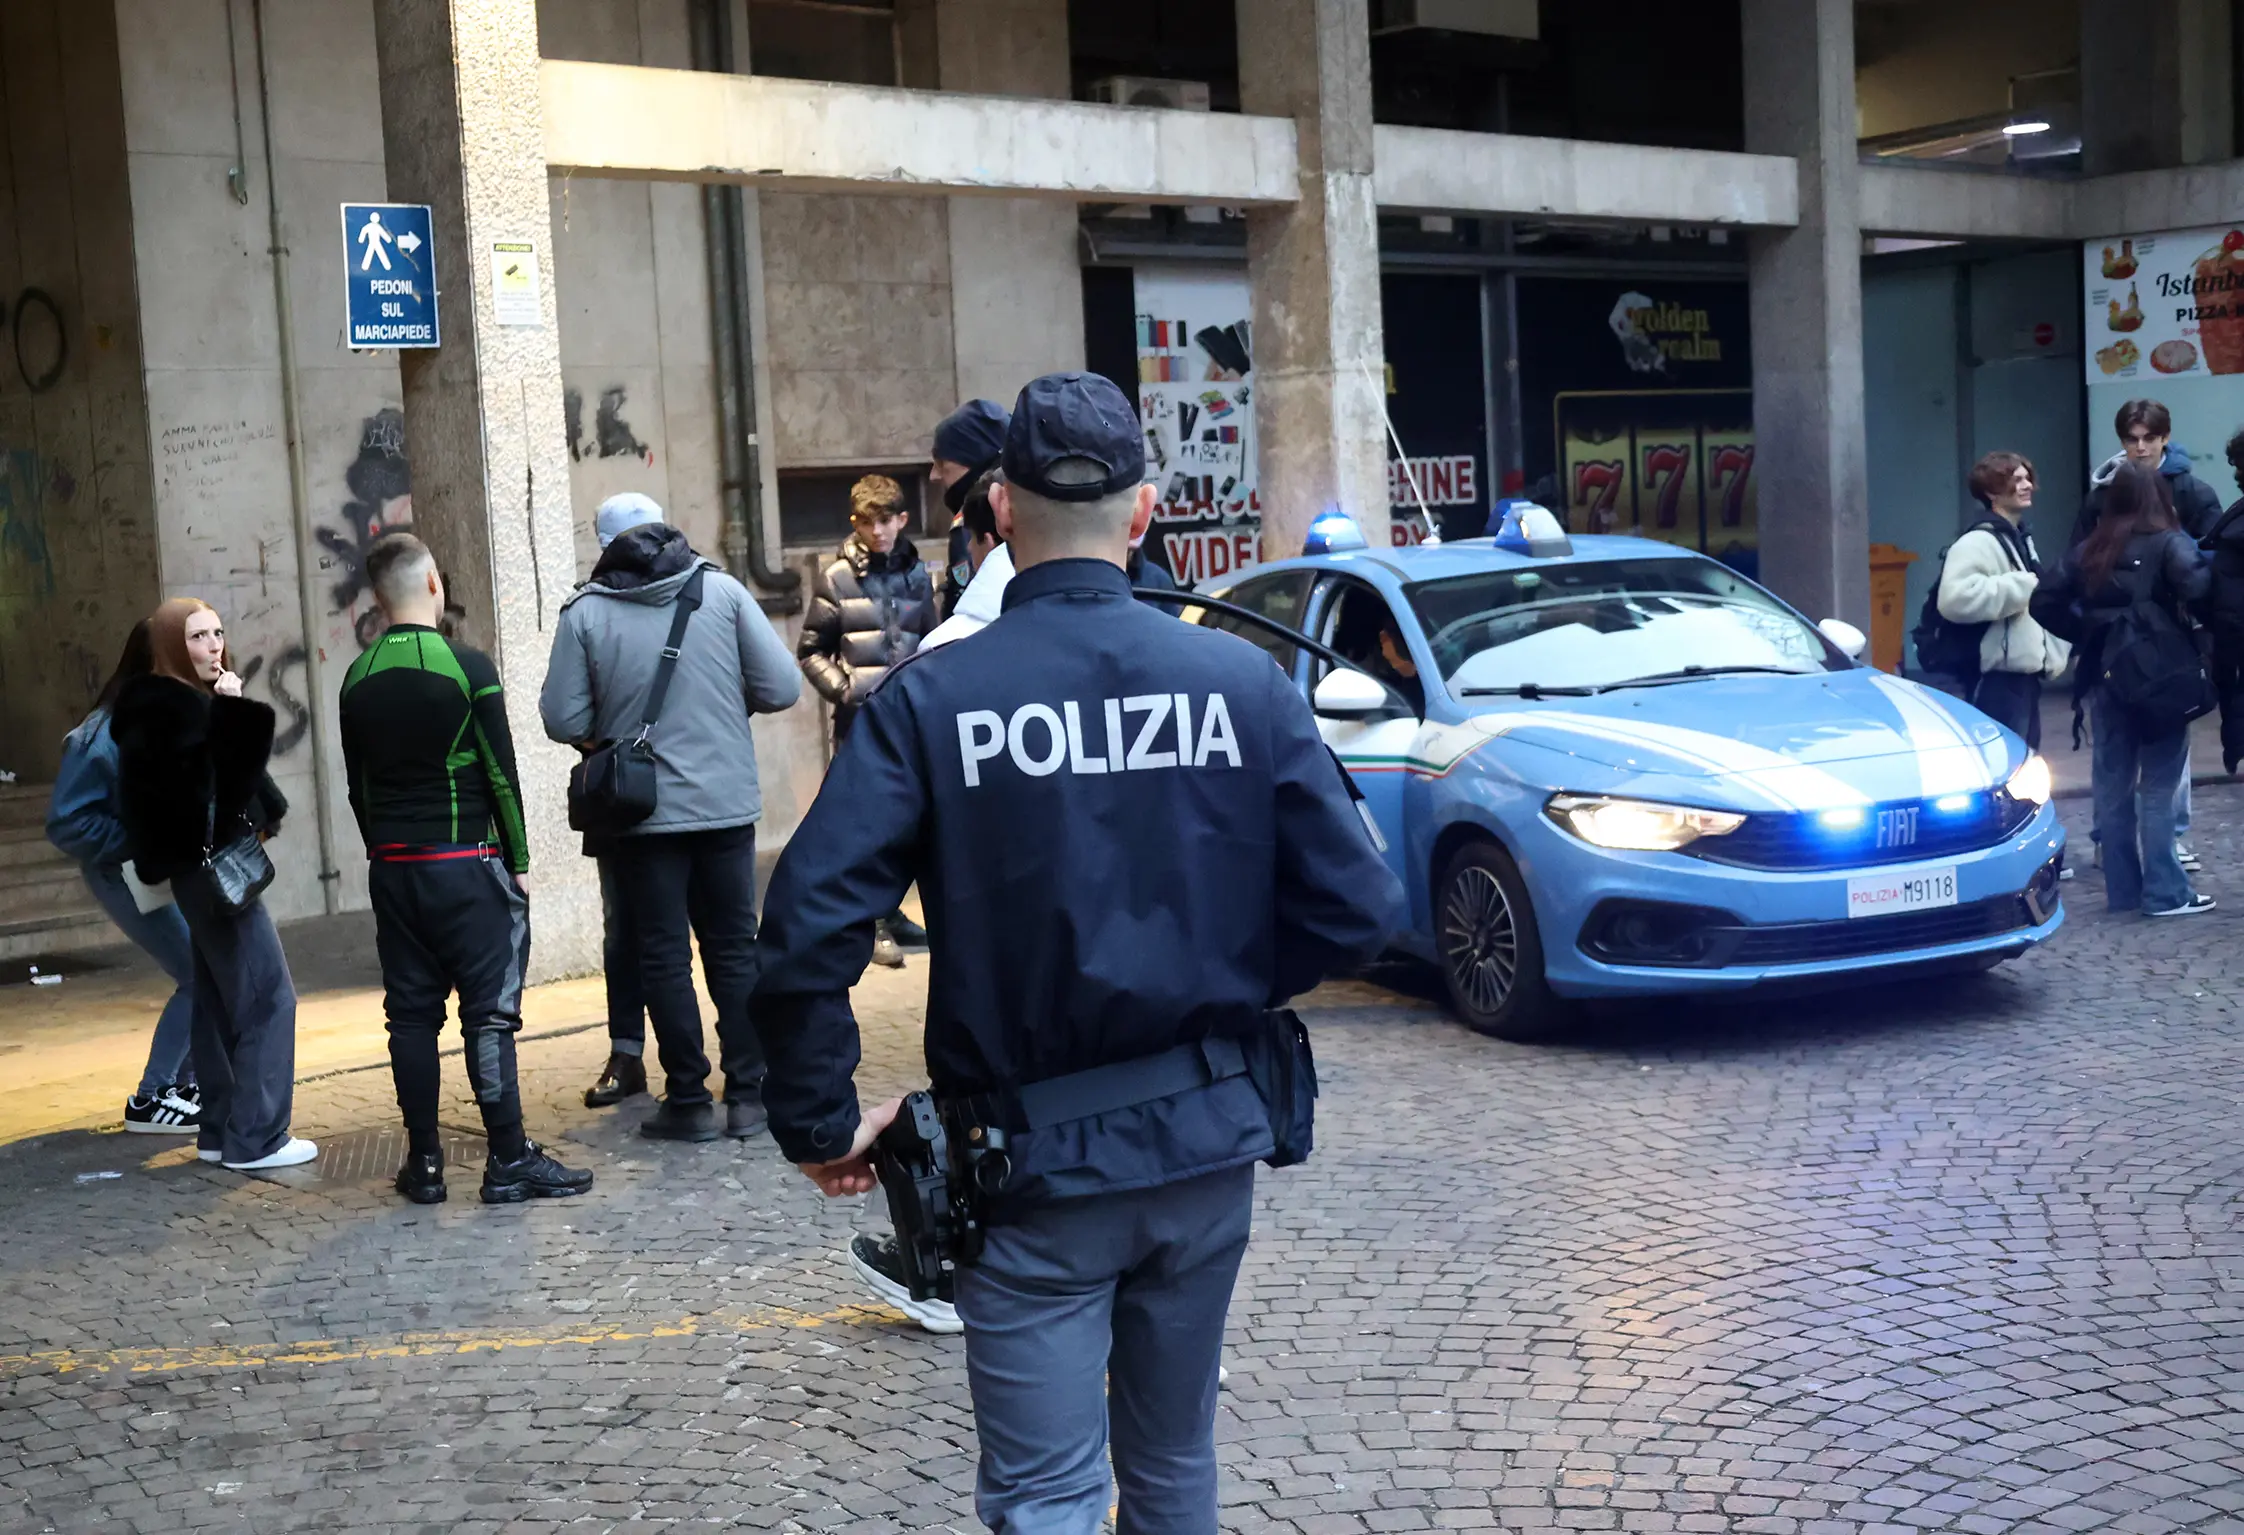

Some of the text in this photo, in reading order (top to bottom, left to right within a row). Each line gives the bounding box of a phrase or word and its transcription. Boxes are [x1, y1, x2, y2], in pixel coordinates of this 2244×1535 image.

[370, 280, 412, 295] PEDONI
[381, 302, 404, 317] SUL
[355, 324, 431, 340] MARCIAPIEDE
[957, 693, 1242, 788] POLIZIA
[1876, 807, 1920, 848] FIAT
[1852, 876, 1954, 904] POLIZIA M9118
